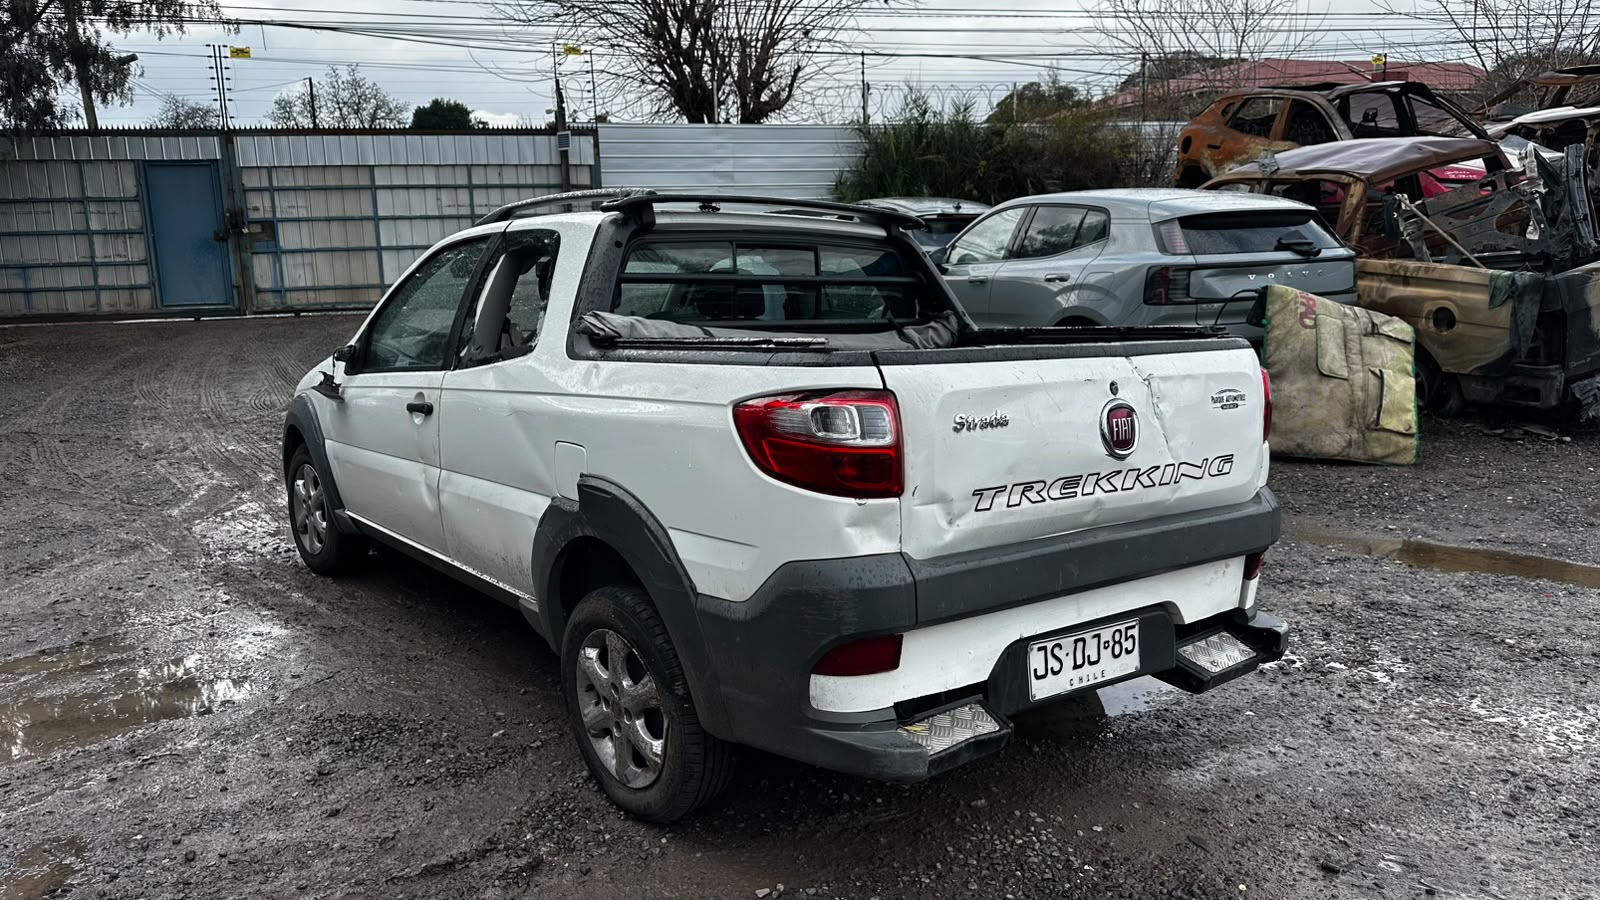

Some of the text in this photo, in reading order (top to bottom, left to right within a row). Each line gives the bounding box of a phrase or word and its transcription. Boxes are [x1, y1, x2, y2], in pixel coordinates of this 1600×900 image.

[952, 409, 1010, 433] Strada
[1112, 417, 1132, 441] FIAT
[972, 453, 1234, 512] TREKKING
[1069, 669, 1106, 687] CHILE
